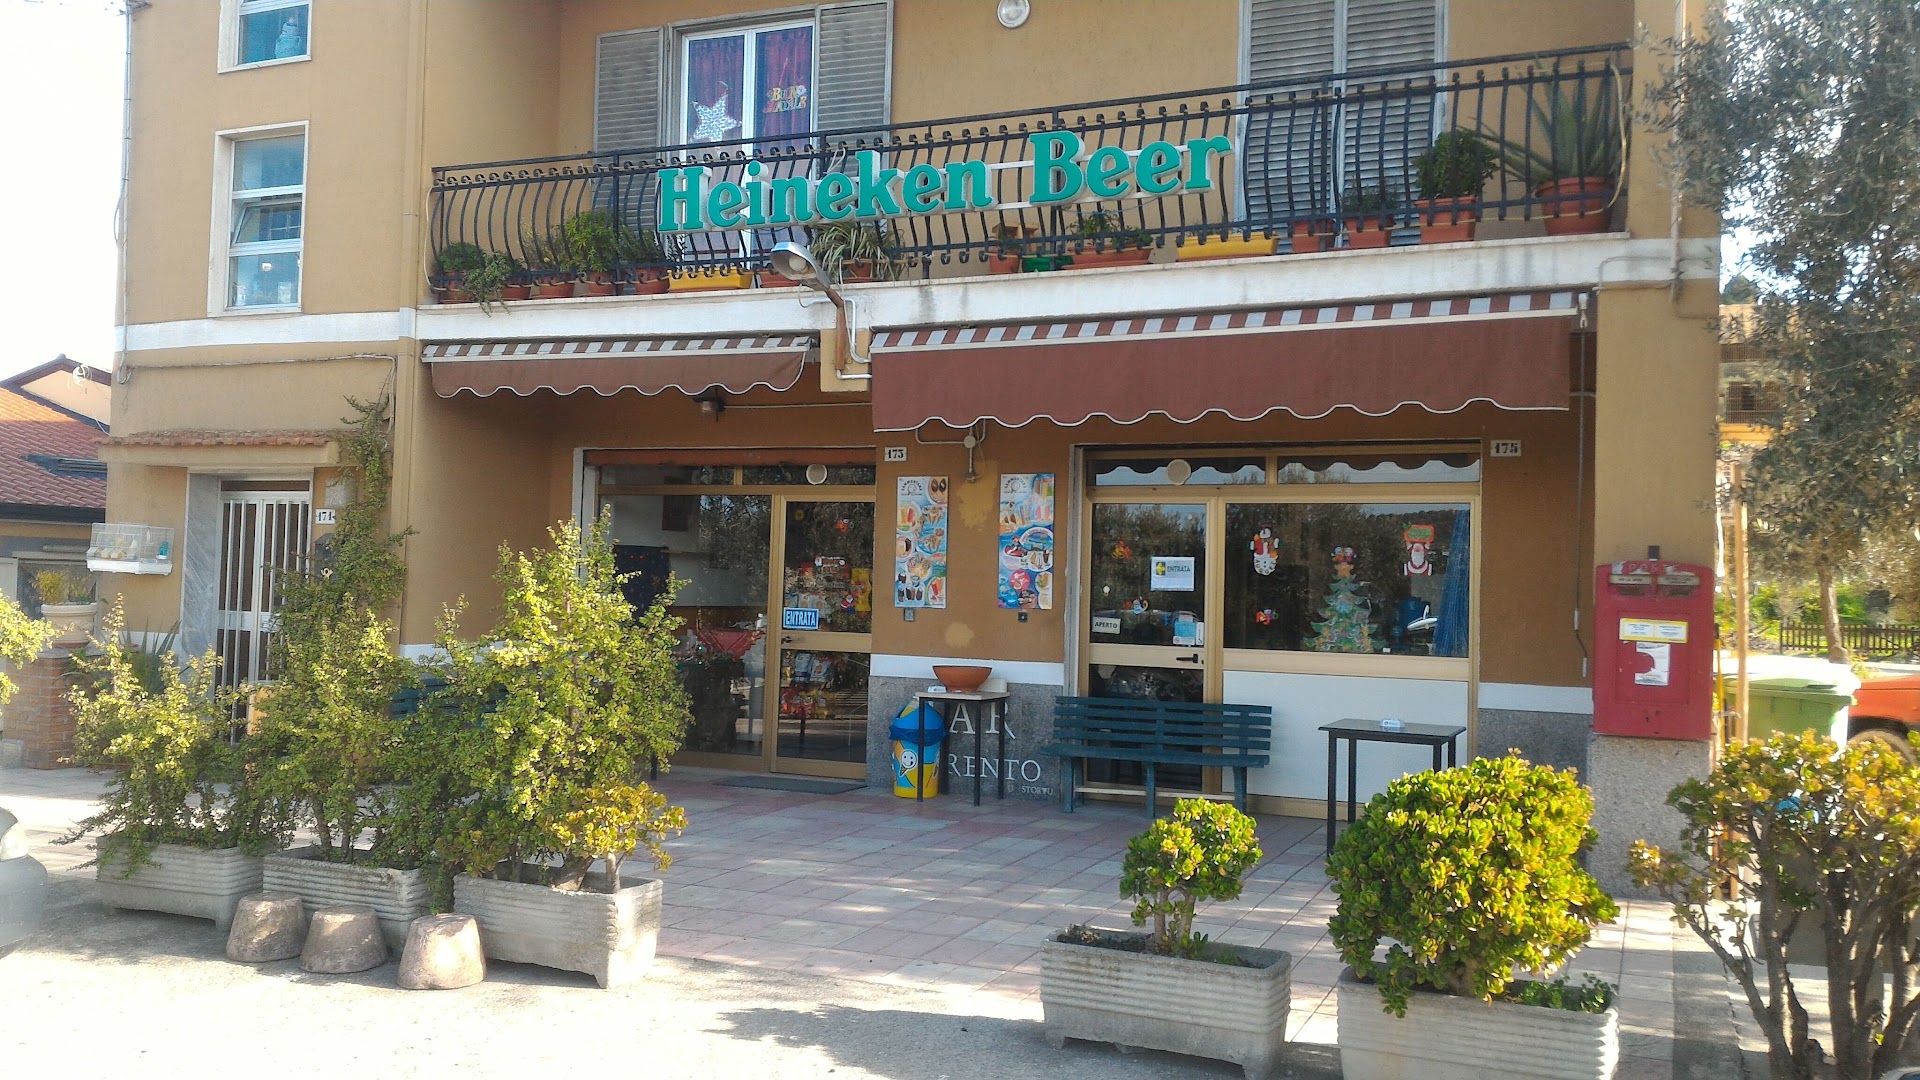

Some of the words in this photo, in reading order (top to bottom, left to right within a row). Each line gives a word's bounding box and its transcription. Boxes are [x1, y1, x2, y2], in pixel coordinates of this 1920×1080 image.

[657, 150, 993, 233] Heineken
[1029, 131, 1232, 206] Beer
[888, 449, 904, 459] 173
[1495, 443, 1518, 454] 175
[318, 511, 332, 521] 171
[1167, 564, 1191, 573] ENTRATA
[786, 610, 816, 626] ENTRATA
[1094, 620, 1118, 629] APERTO
[949, 702, 1016, 740] AR
[948, 753, 1041, 782] RENTO
